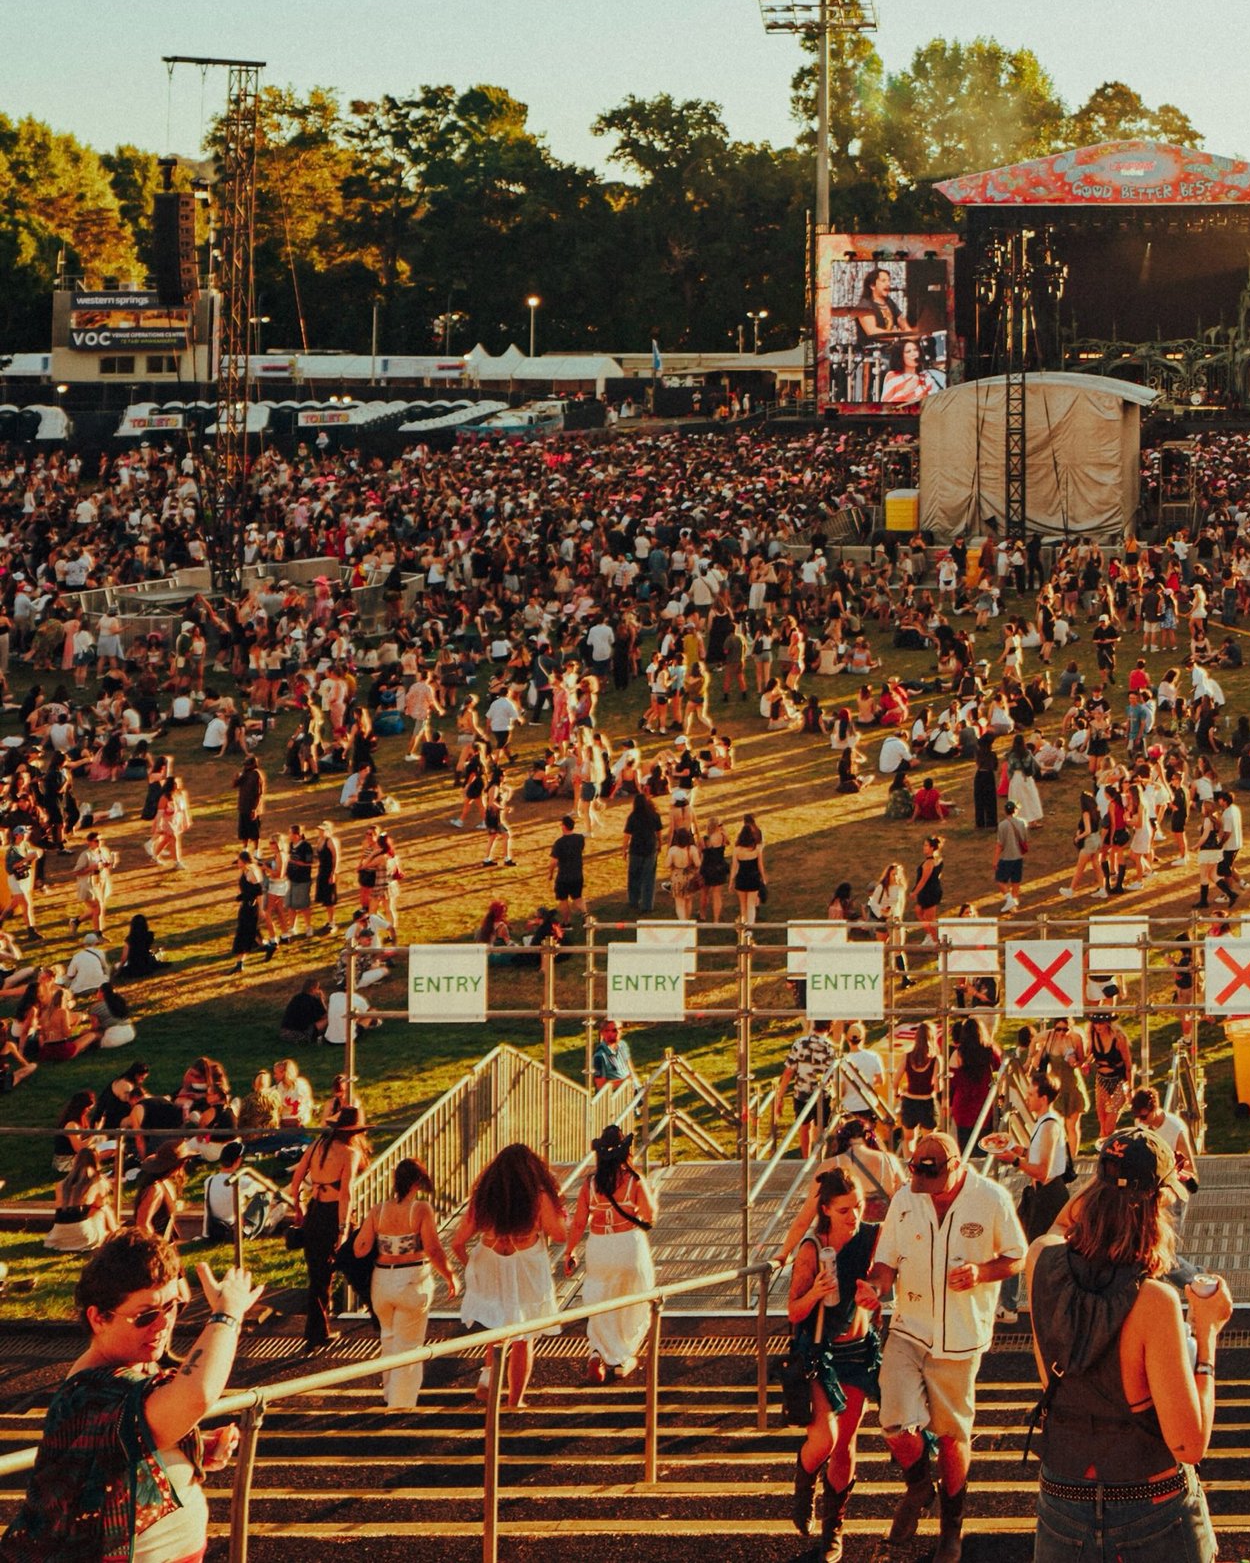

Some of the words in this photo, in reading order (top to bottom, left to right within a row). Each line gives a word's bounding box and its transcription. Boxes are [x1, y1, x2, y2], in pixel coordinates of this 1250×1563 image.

[1072, 181, 1113, 199] GOOD
[1121, 184, 1172, 199] BETTER
[1180, 180, 1214, 197] BEST
[76, 295, 115, 305] western
[116, 295, 149, 306] springs
[72, 331, 112, 346] VOC
[129, 417, 178, 428] TOILETS
[302, 413, 349, 424] TOILETS
[413, 976, 482, 993] ENTRY
[612, 975, 680, 991] ENTRY
[811, 974, 880, 991] ENTRY
